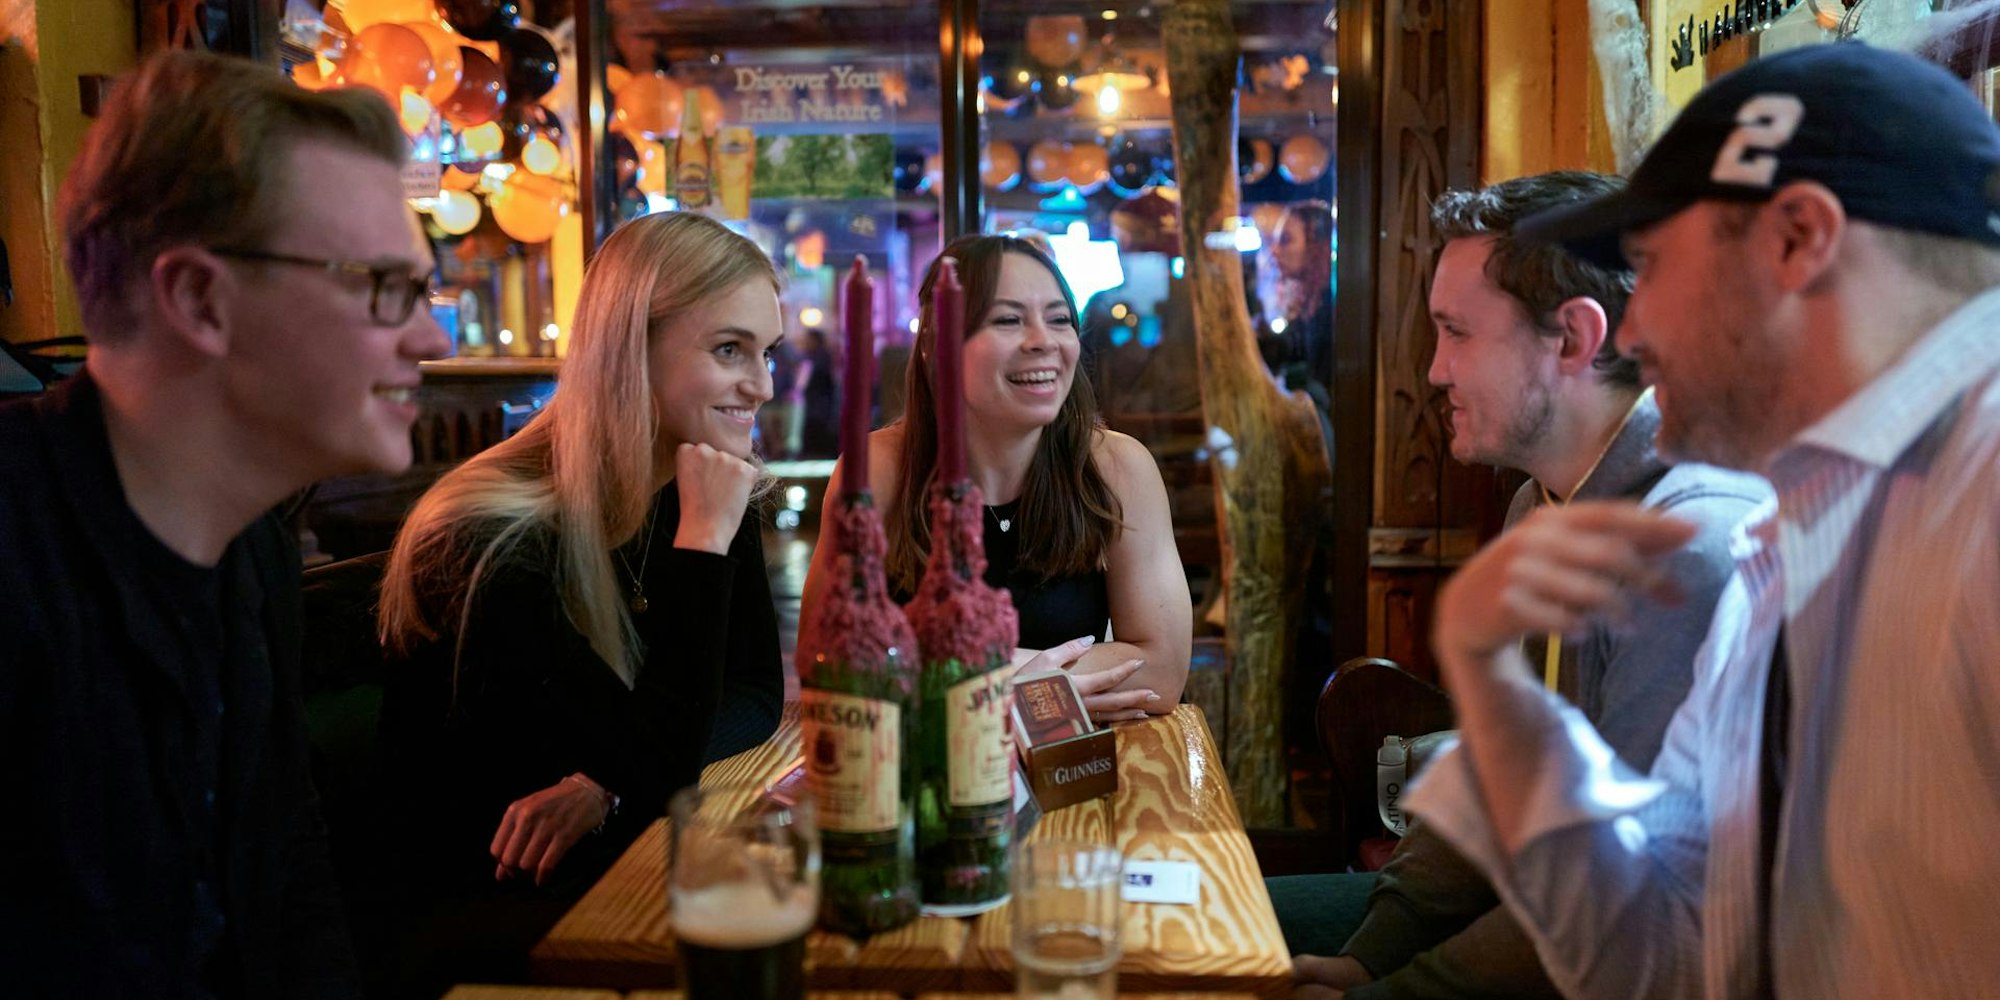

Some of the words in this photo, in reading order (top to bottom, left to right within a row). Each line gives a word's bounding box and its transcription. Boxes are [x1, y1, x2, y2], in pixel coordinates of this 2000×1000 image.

[734, 66, 829, 91] Discover
[831, 65, 883, 90] Your
[741, 99, 793, 122] Irish
[799, 99, 882, 122] Nature
[1711, 93, 1805, 187] 2
[1055, 757, 1112, 785] GUINNESS
